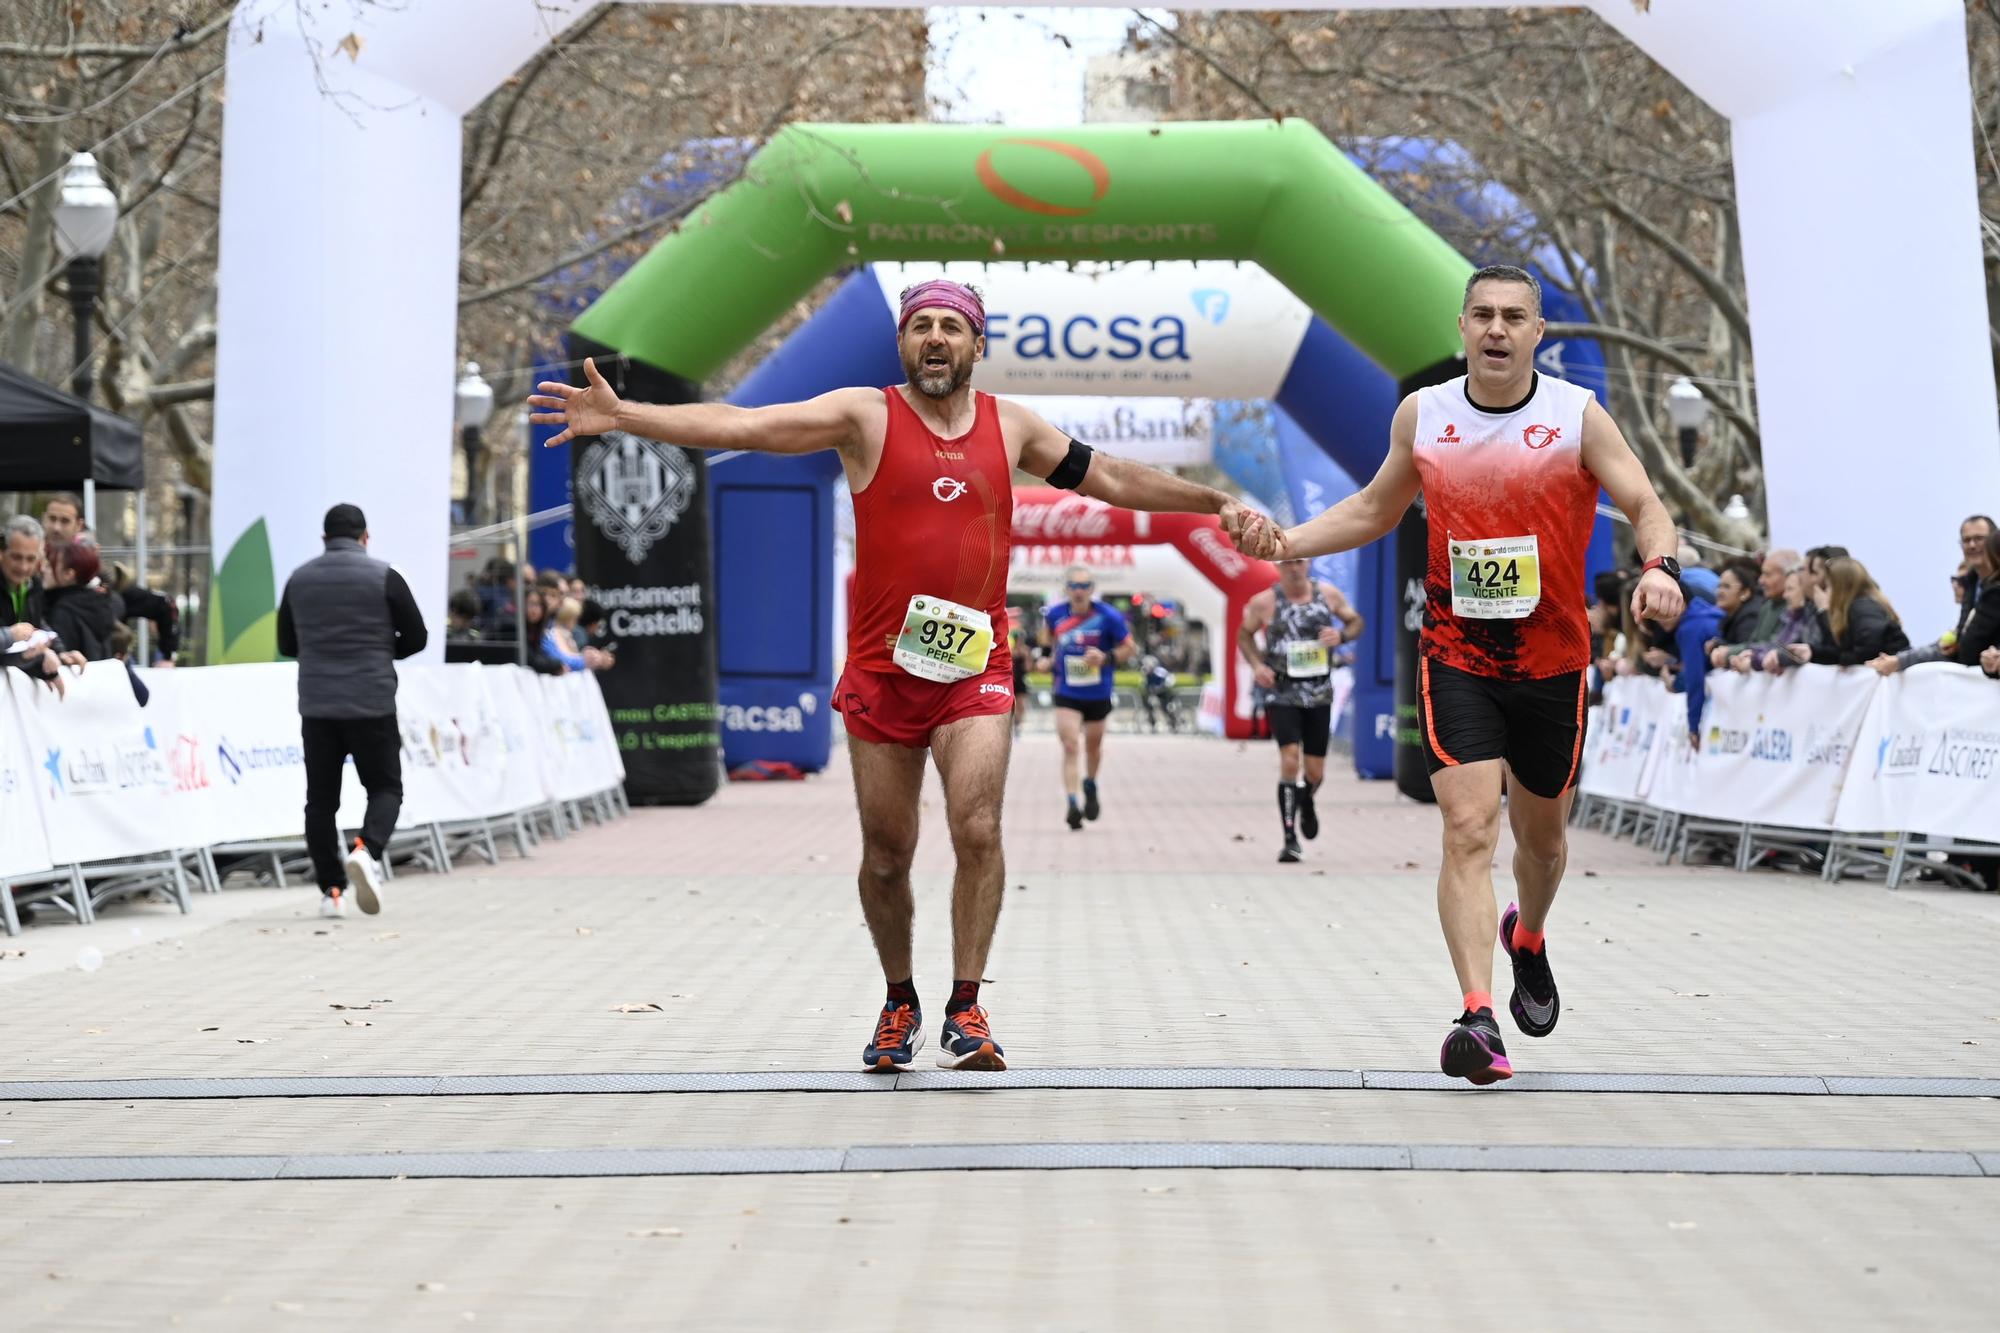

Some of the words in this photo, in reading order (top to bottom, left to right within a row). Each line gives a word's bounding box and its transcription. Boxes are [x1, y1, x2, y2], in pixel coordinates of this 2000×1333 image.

[1467, 558, 1520, 588] 424
[1472, 586, 1518, 599] VICENTE
[919, 619, 976, 654] 937
[926, 647, 957, 664] PEPE
